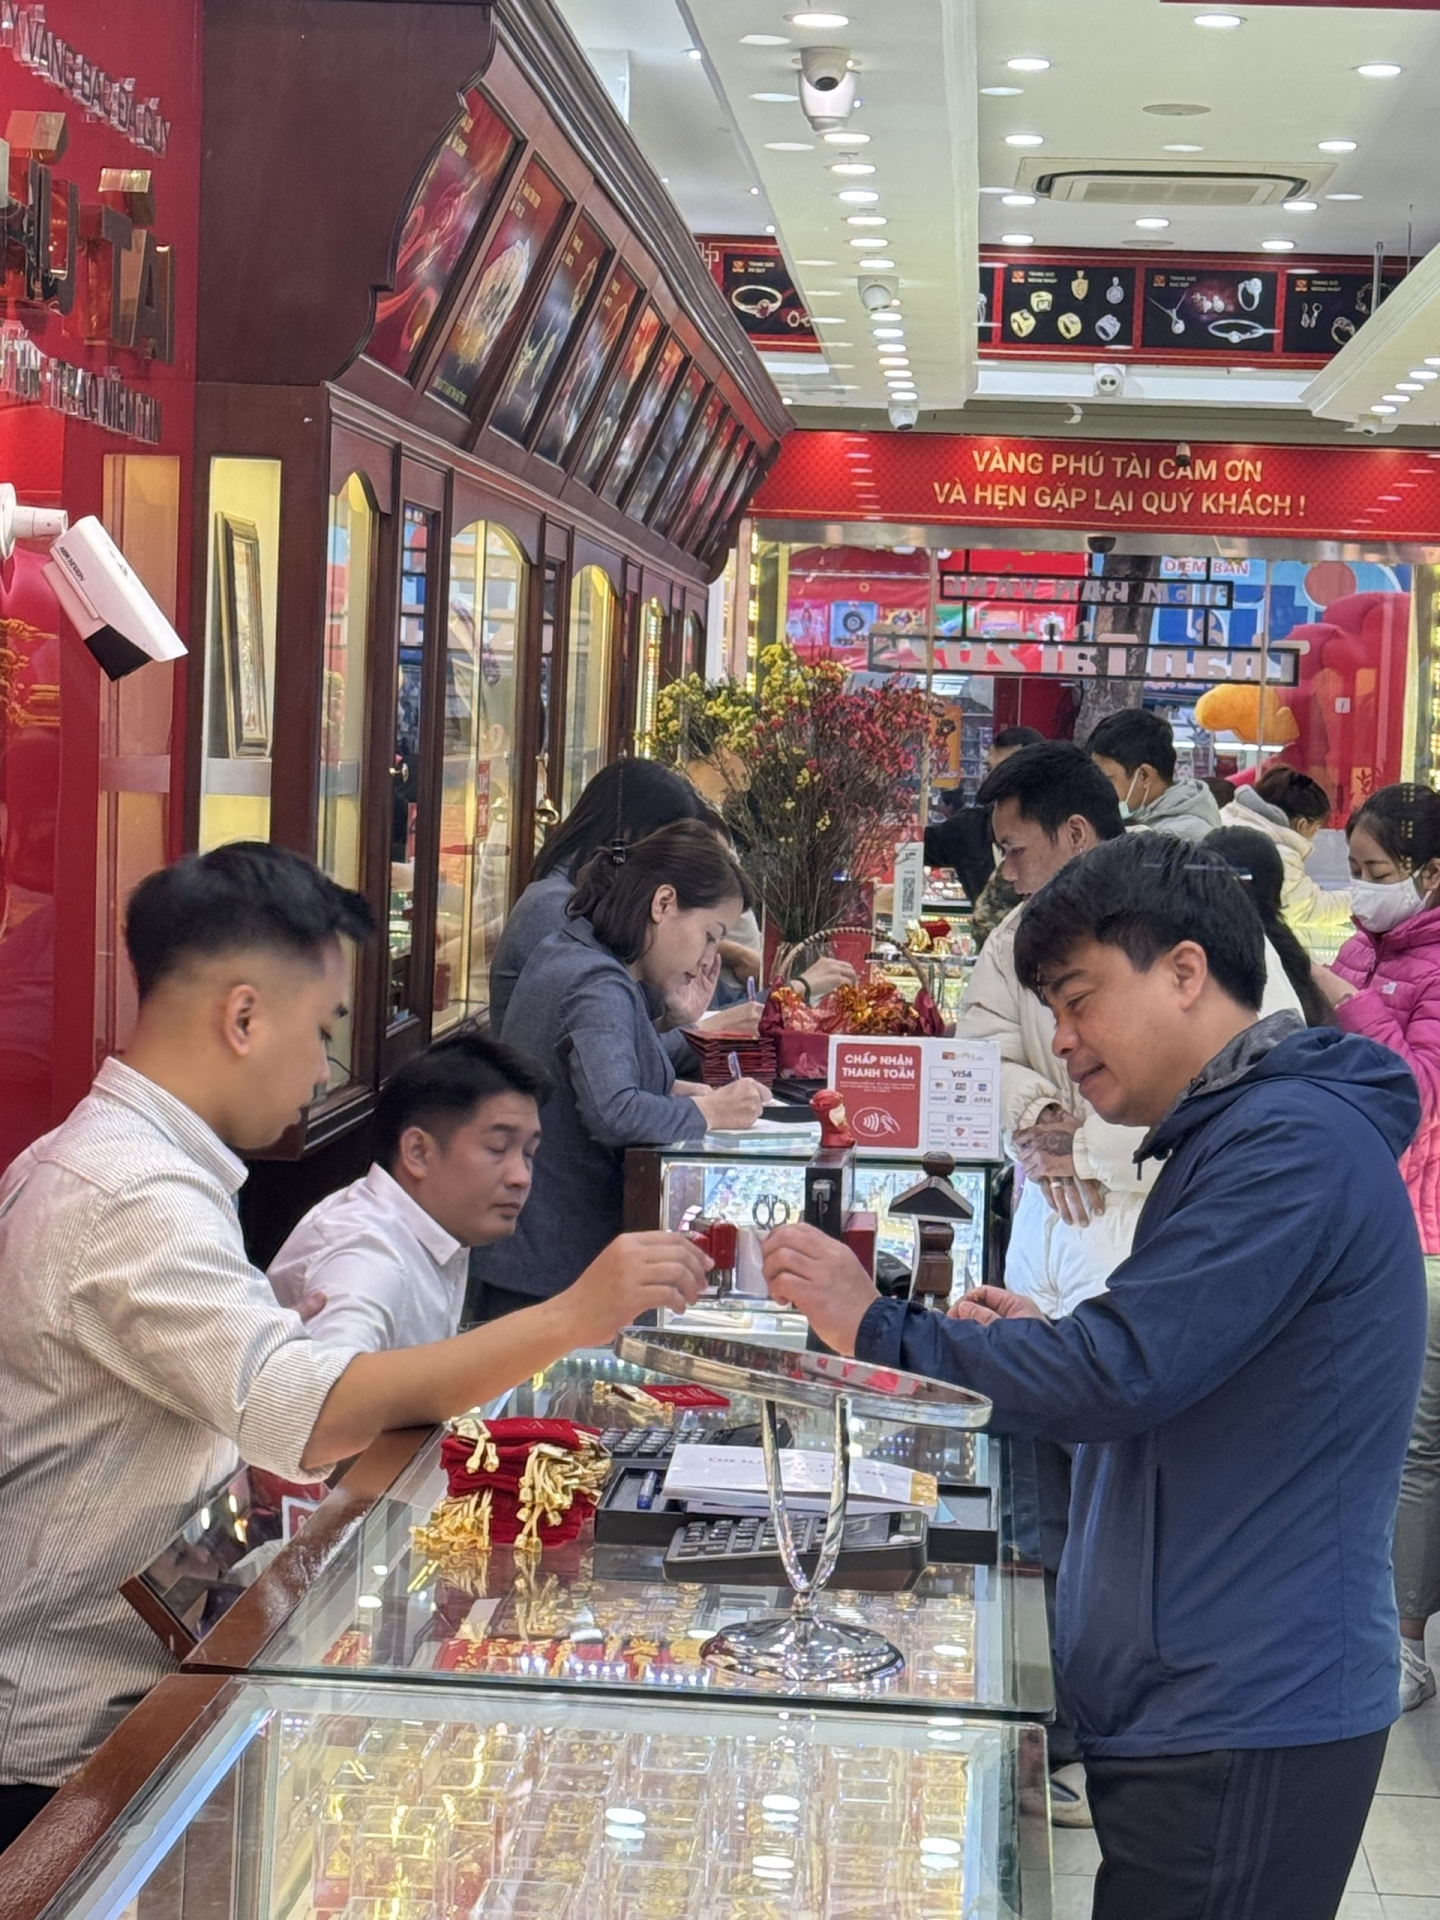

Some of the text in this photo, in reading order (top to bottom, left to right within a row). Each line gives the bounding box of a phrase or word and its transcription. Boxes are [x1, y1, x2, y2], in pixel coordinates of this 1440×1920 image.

[972, 446, 1043, 475] VÀNG
[1051, 450, 1104, 477] PHÚ
[1111, 452, 1150, 479] TÀI
[1225, 459, 1262, 482] ƠN
[933, 478, 967, 504] VÀ
[974, 483, 1026, 511] HẸN
[1034, 481, 1087, 513] GẶP
[1094, 489, 1133, 517] LẠI
[1141, 486, 1194, 516] QUÝ
[1201, 488, 1291, 517] KHÁCH
[844, 1051, 877, 1065] CHẤP
[842, 1066, 915, 1079] THANH TOÁN
[951, 1069, 972, 1078] VISA
